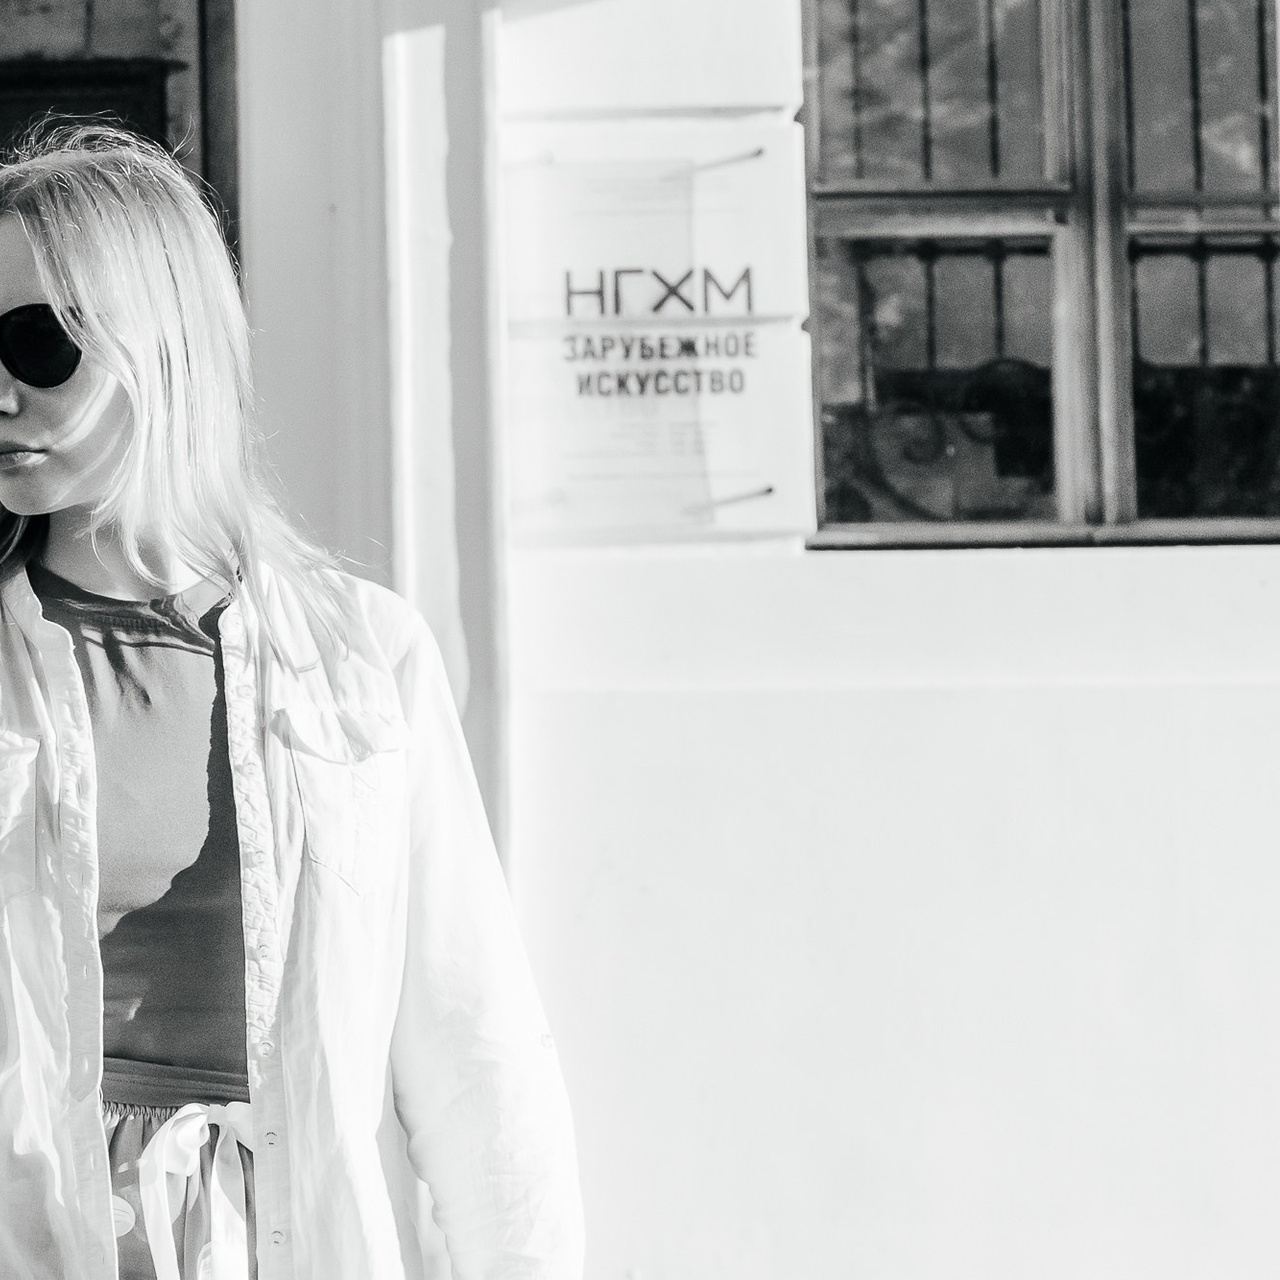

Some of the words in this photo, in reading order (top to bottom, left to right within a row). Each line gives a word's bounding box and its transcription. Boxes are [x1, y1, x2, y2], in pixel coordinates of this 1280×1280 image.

[565, 267, 752, 315] НГХМ
[563, 332, 757, 361] ЗАРУБЕЖНОЕ
[577, 368, 746, 397] ИСКУССТВО
